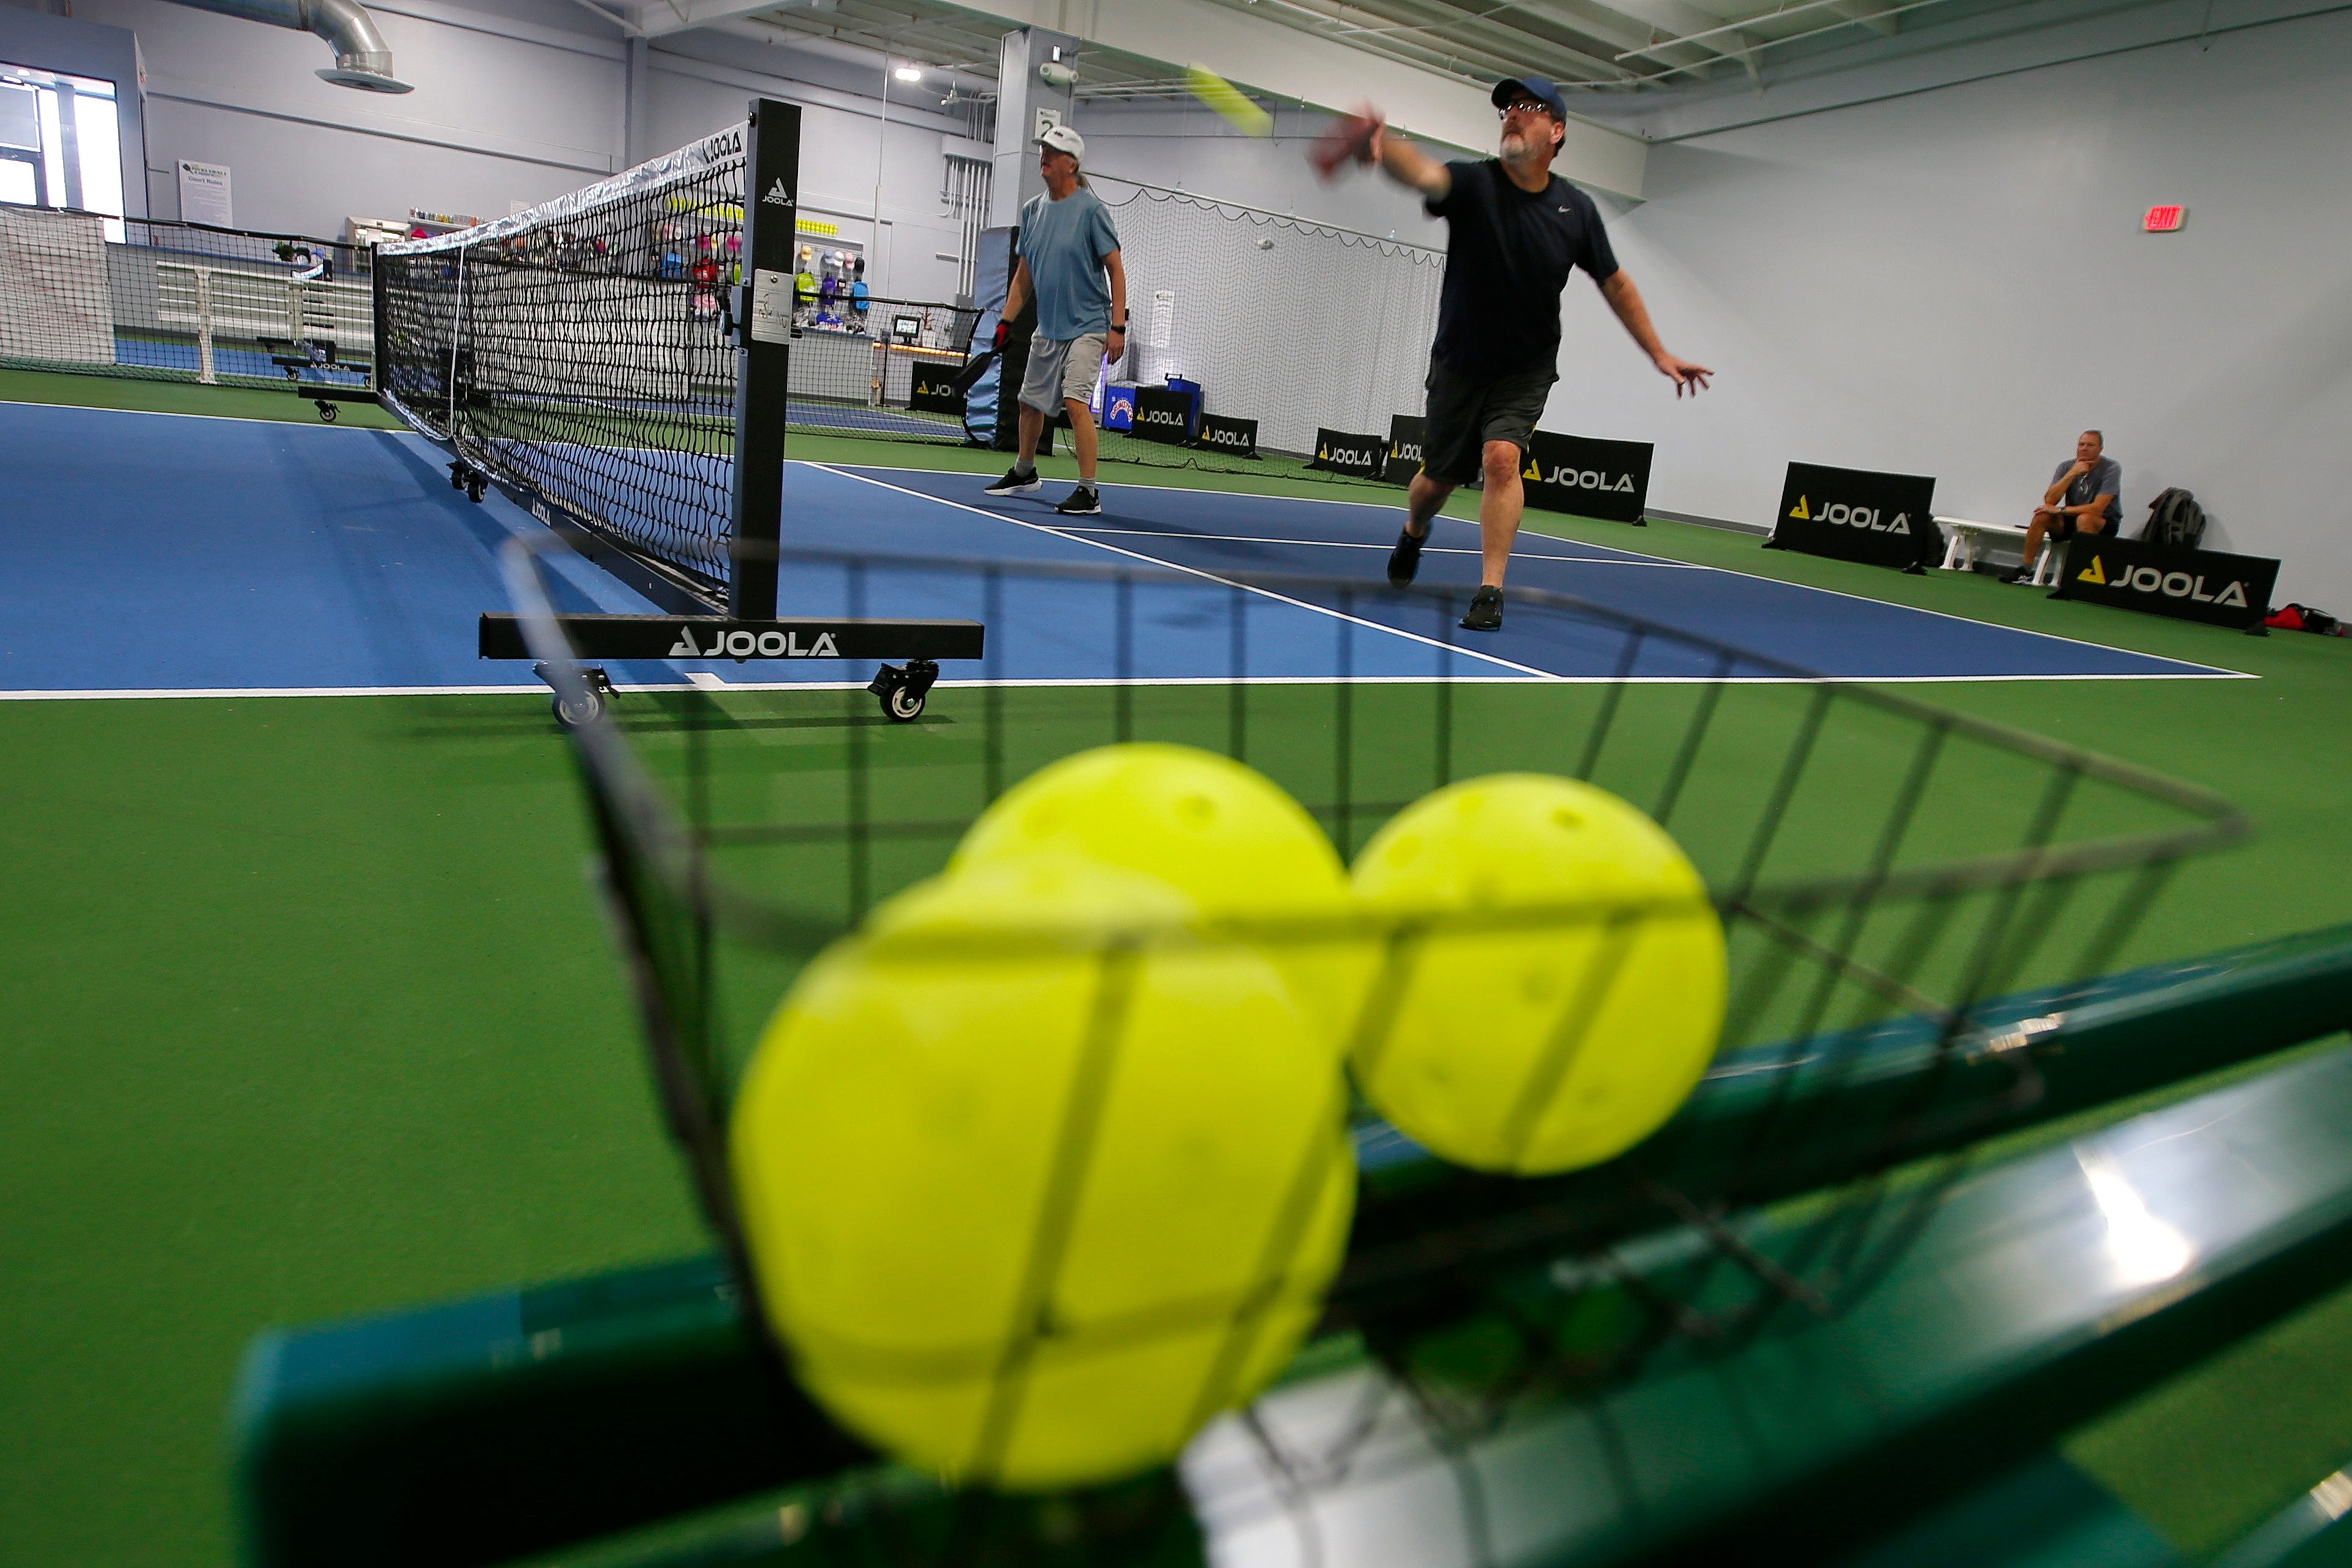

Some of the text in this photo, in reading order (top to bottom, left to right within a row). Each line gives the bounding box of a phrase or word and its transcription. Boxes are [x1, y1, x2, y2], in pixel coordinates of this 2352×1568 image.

[710, 130, 742, 162] JOOLA
[762, 195, 794, 208] JOOLA
[2149, 207, 2180, 228] EXIT
[318, 363, 351, 372] JOOLA
[1146, 410, 1184, 426] JOOLA
[1211, 428, 1250, 447] JOOLA
[1328, 447, 1372, 466] JOOLA
[1399, 443, 1424, 462] JOOL
[1544, 466, 1635, 493] JOOLA
[1812, 502, 1911, 535] JOOLA
[2108, 565, 2248, 608] JOOLA
[703, 630, 841, 657] JOOLA
